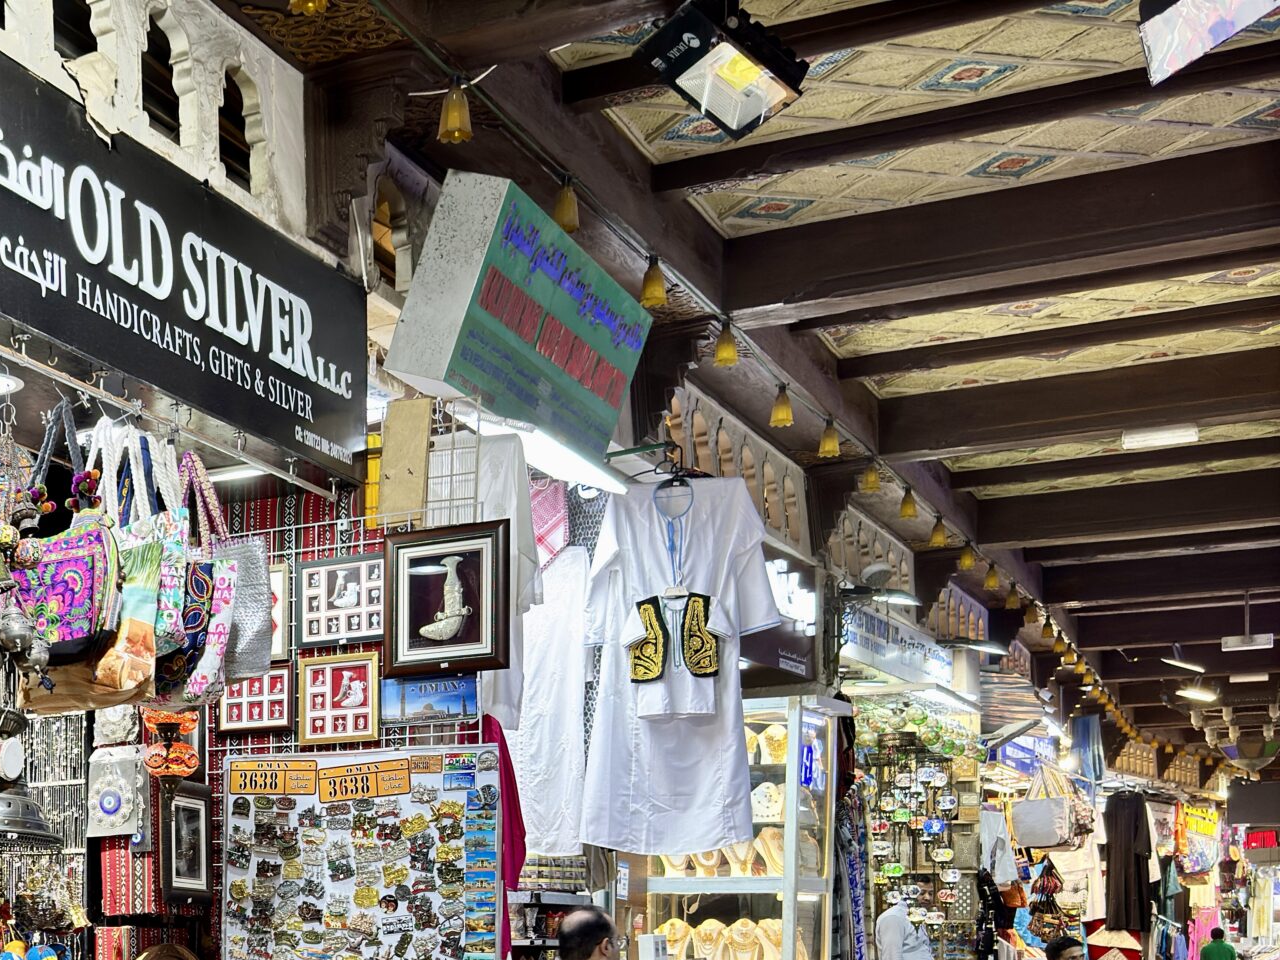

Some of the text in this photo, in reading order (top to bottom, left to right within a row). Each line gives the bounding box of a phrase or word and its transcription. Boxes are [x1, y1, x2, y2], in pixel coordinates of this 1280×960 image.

[0, 235, 67, 298] التحف
[68, 164, 174, 301] OLD
[181, 231, 318, 383] SILVER
[76, 272, 315, 424] HANDICRAFTS, GIFTS & SILVER
[418, 680, 460, 694] OMAN
[346, 764, 380, 773] OMAN
[239, 771, 278, 790] 3638
[328, 775, 370, 798] 3638
